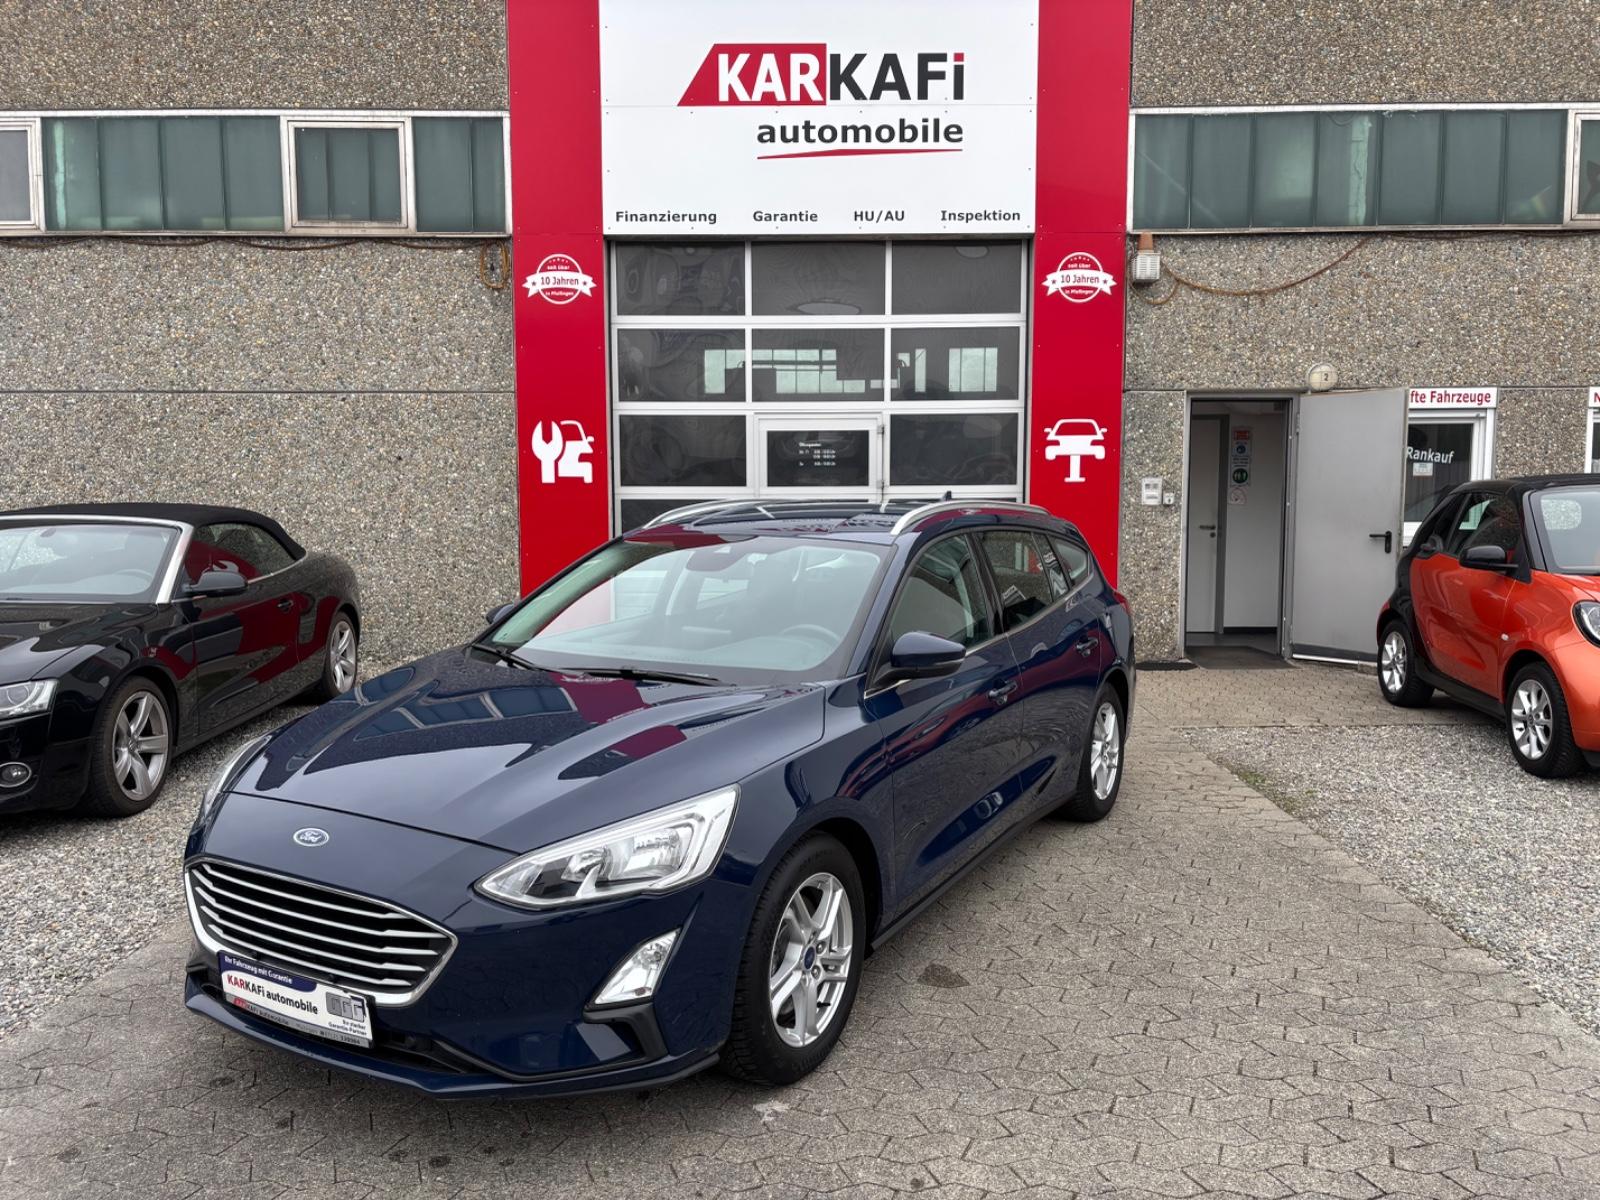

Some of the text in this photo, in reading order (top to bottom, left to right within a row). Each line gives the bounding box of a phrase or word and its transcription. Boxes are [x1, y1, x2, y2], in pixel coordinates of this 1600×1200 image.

[717, 52, 965, 102] KARKAFi
[757, 118, 964, 144] automobile
[615, 209, 1021, 225] Finanzierung Garantie HU/AU Inspektion
[540, 276, 579, 286] 10 Jahren
[1060, 274, 1100, 284] 10 Jahren
[1430, 389, 1492, 406] Fahrzeuge
[232, 958, 258, 974] Fahrzeug
[267, 970, 293, 985] Garantie
[226, 974, 319, 1015] KARKAFi automobile
